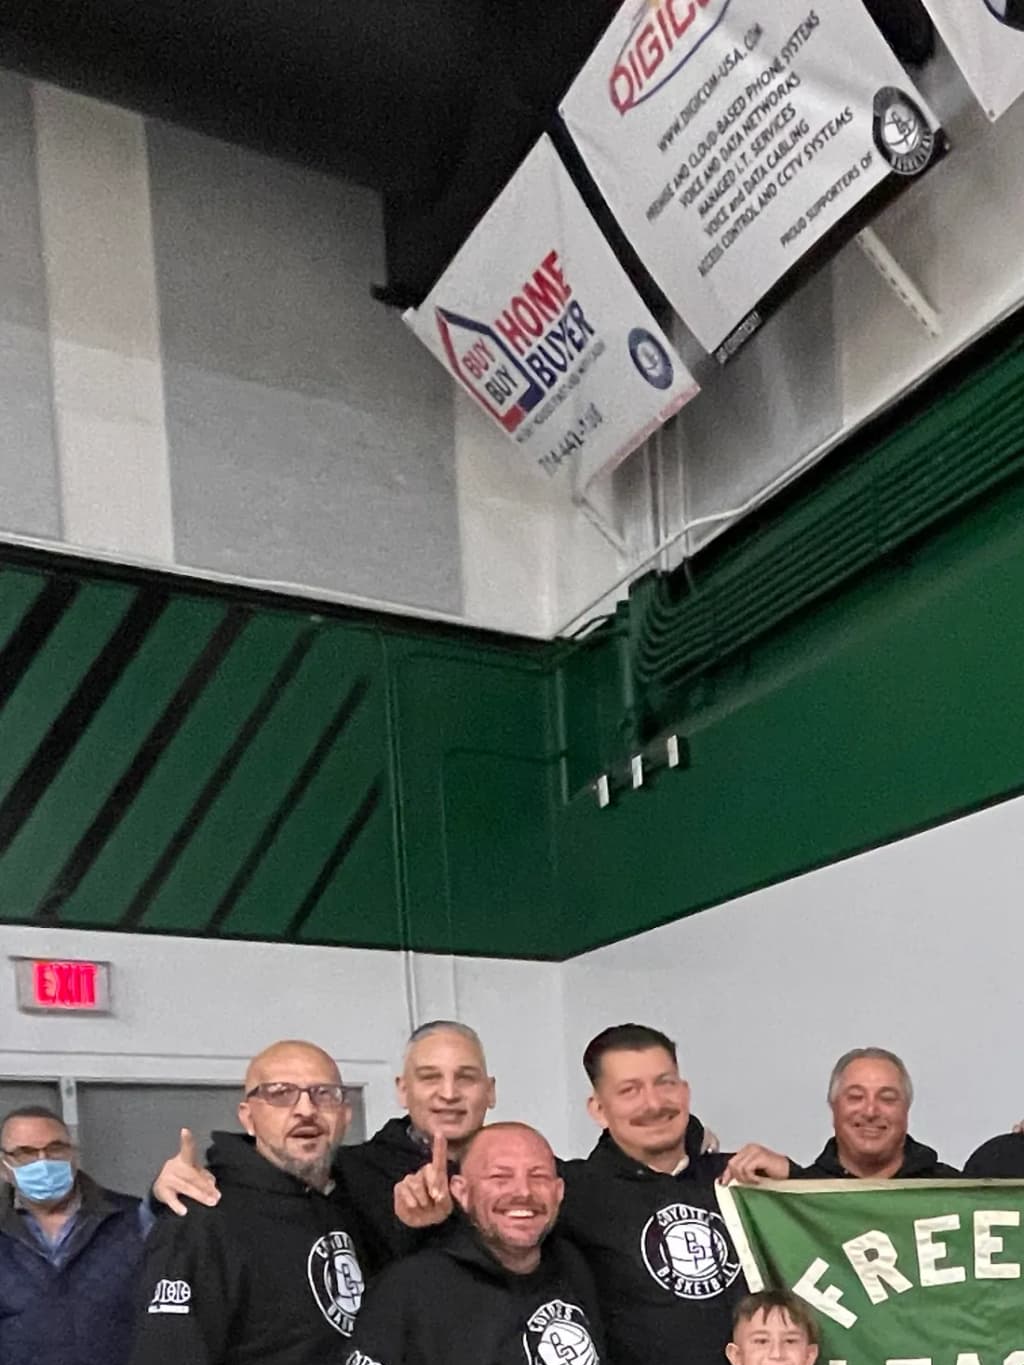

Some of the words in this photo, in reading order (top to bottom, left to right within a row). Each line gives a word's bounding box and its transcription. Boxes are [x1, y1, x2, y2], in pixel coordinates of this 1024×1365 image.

[609, 0, 713, 116] DIGIC
[673, 163, 690, 188] AND
[745, 58, 785, 100] PHONE
[781, 9, 820, 64] SYSTEMS
[699, 168, 737, 217] MANAGED
[750, 102, 797, 157] SERVICES
[705, 157, 721, 182] AND
[719, 132, 744, 162] DATA
[743, 71, 801, 136] NETWORKS
[743, 168, 769, 196] DATA
[766, 118, 810, 170] CABLING
[860, 151, 874, 171] OF
[721, 206, 760, 250] CONTROL
[758, 182, 778, 211] AND
[776, 157, 805, 188] CCTV
[803, 106, 854, 161] SYSTEMS
[495, 249, 572, 356] HOME
[526, 299, 596, 389] BUYER
[462, 338, 496, 380] BUY
[485, 365, 519, 406] BUY
[36, 961, 97, 1007] EXIT
